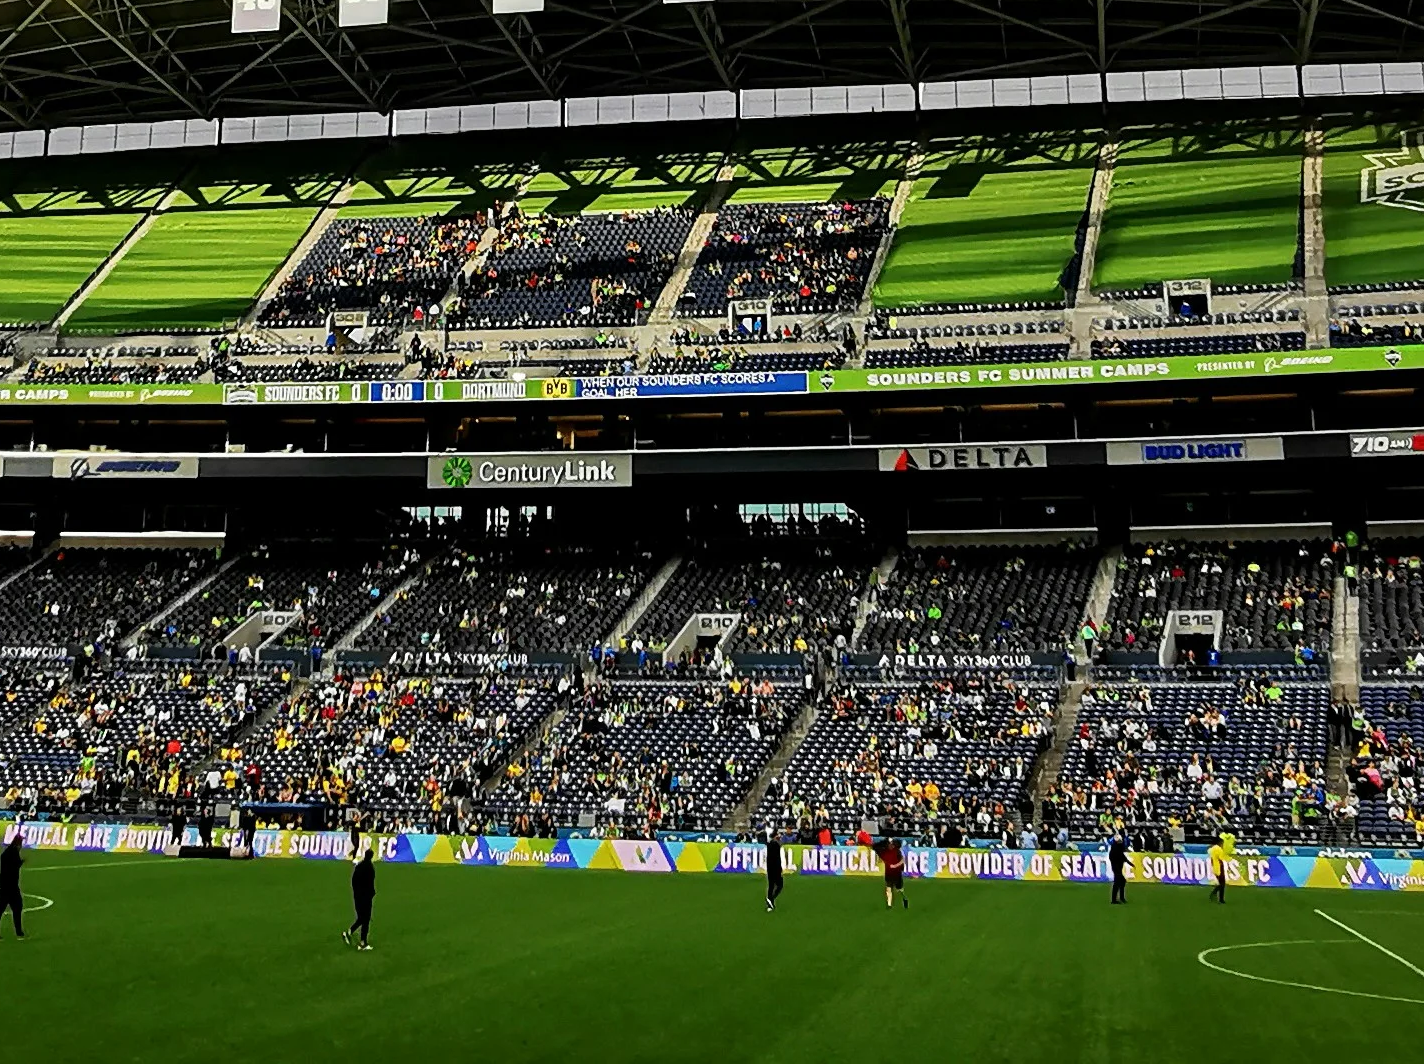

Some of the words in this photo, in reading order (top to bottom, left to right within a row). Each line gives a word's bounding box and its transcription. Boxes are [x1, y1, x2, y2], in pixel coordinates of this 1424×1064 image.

[1280, 354, 1334, 367] BOEING
[581, 378, 614, 388] WHEN
[616, 377, 640, 387] OUR
[641, 375, 701, 387] SOUNDERS
[703, 374, 719, 386] FC
[720, 373, 765, 385] SCORES
[866, 370, 971, 388] SOUNDERS
[978, 367, 1003, 383] FC
[1008, 366, 1095, 383] SUMMER
[1100, 362, 1170, 378] CAMPS
[13, 388, 69, 401] CAMPS
[265, 385, 323, 401] SOUNDERS
[325, 385, 340, 401] FC
[351, 384, 361, 400] 0
[381, 383, 412, 401] 0:00
[434, 382, 444, 400] 0
[462, 381, 527, 399] DORTMUND
[546, 379, 568, 396] BVB
[1145, 444, 1184, 461] BUD
[1187, 442, 1244, 460] LIGHT
[1353, 436, 1388, 452] 710
[928, 448, 1034, 469] DELTA
[478, 460, 615, 486] CenturyLink
[1178, 614, 1213, 626] 212
[895, 654, 948, 667] DELTA
[4, 823, 68, 847] MEDICAL
[74, 826, 111, 849] CARE
[378, 835, 398, 858] FC
[488, 847, 530, 863] Virginia
[532, 848, 571, 863] Mason
[802, 848, 880, 873] MEDICAL
[937, 850, 1025, 877] PROVIDER
[1030, 853, 1053, 877] OF
[1247, 859, 1272, 883] FC
